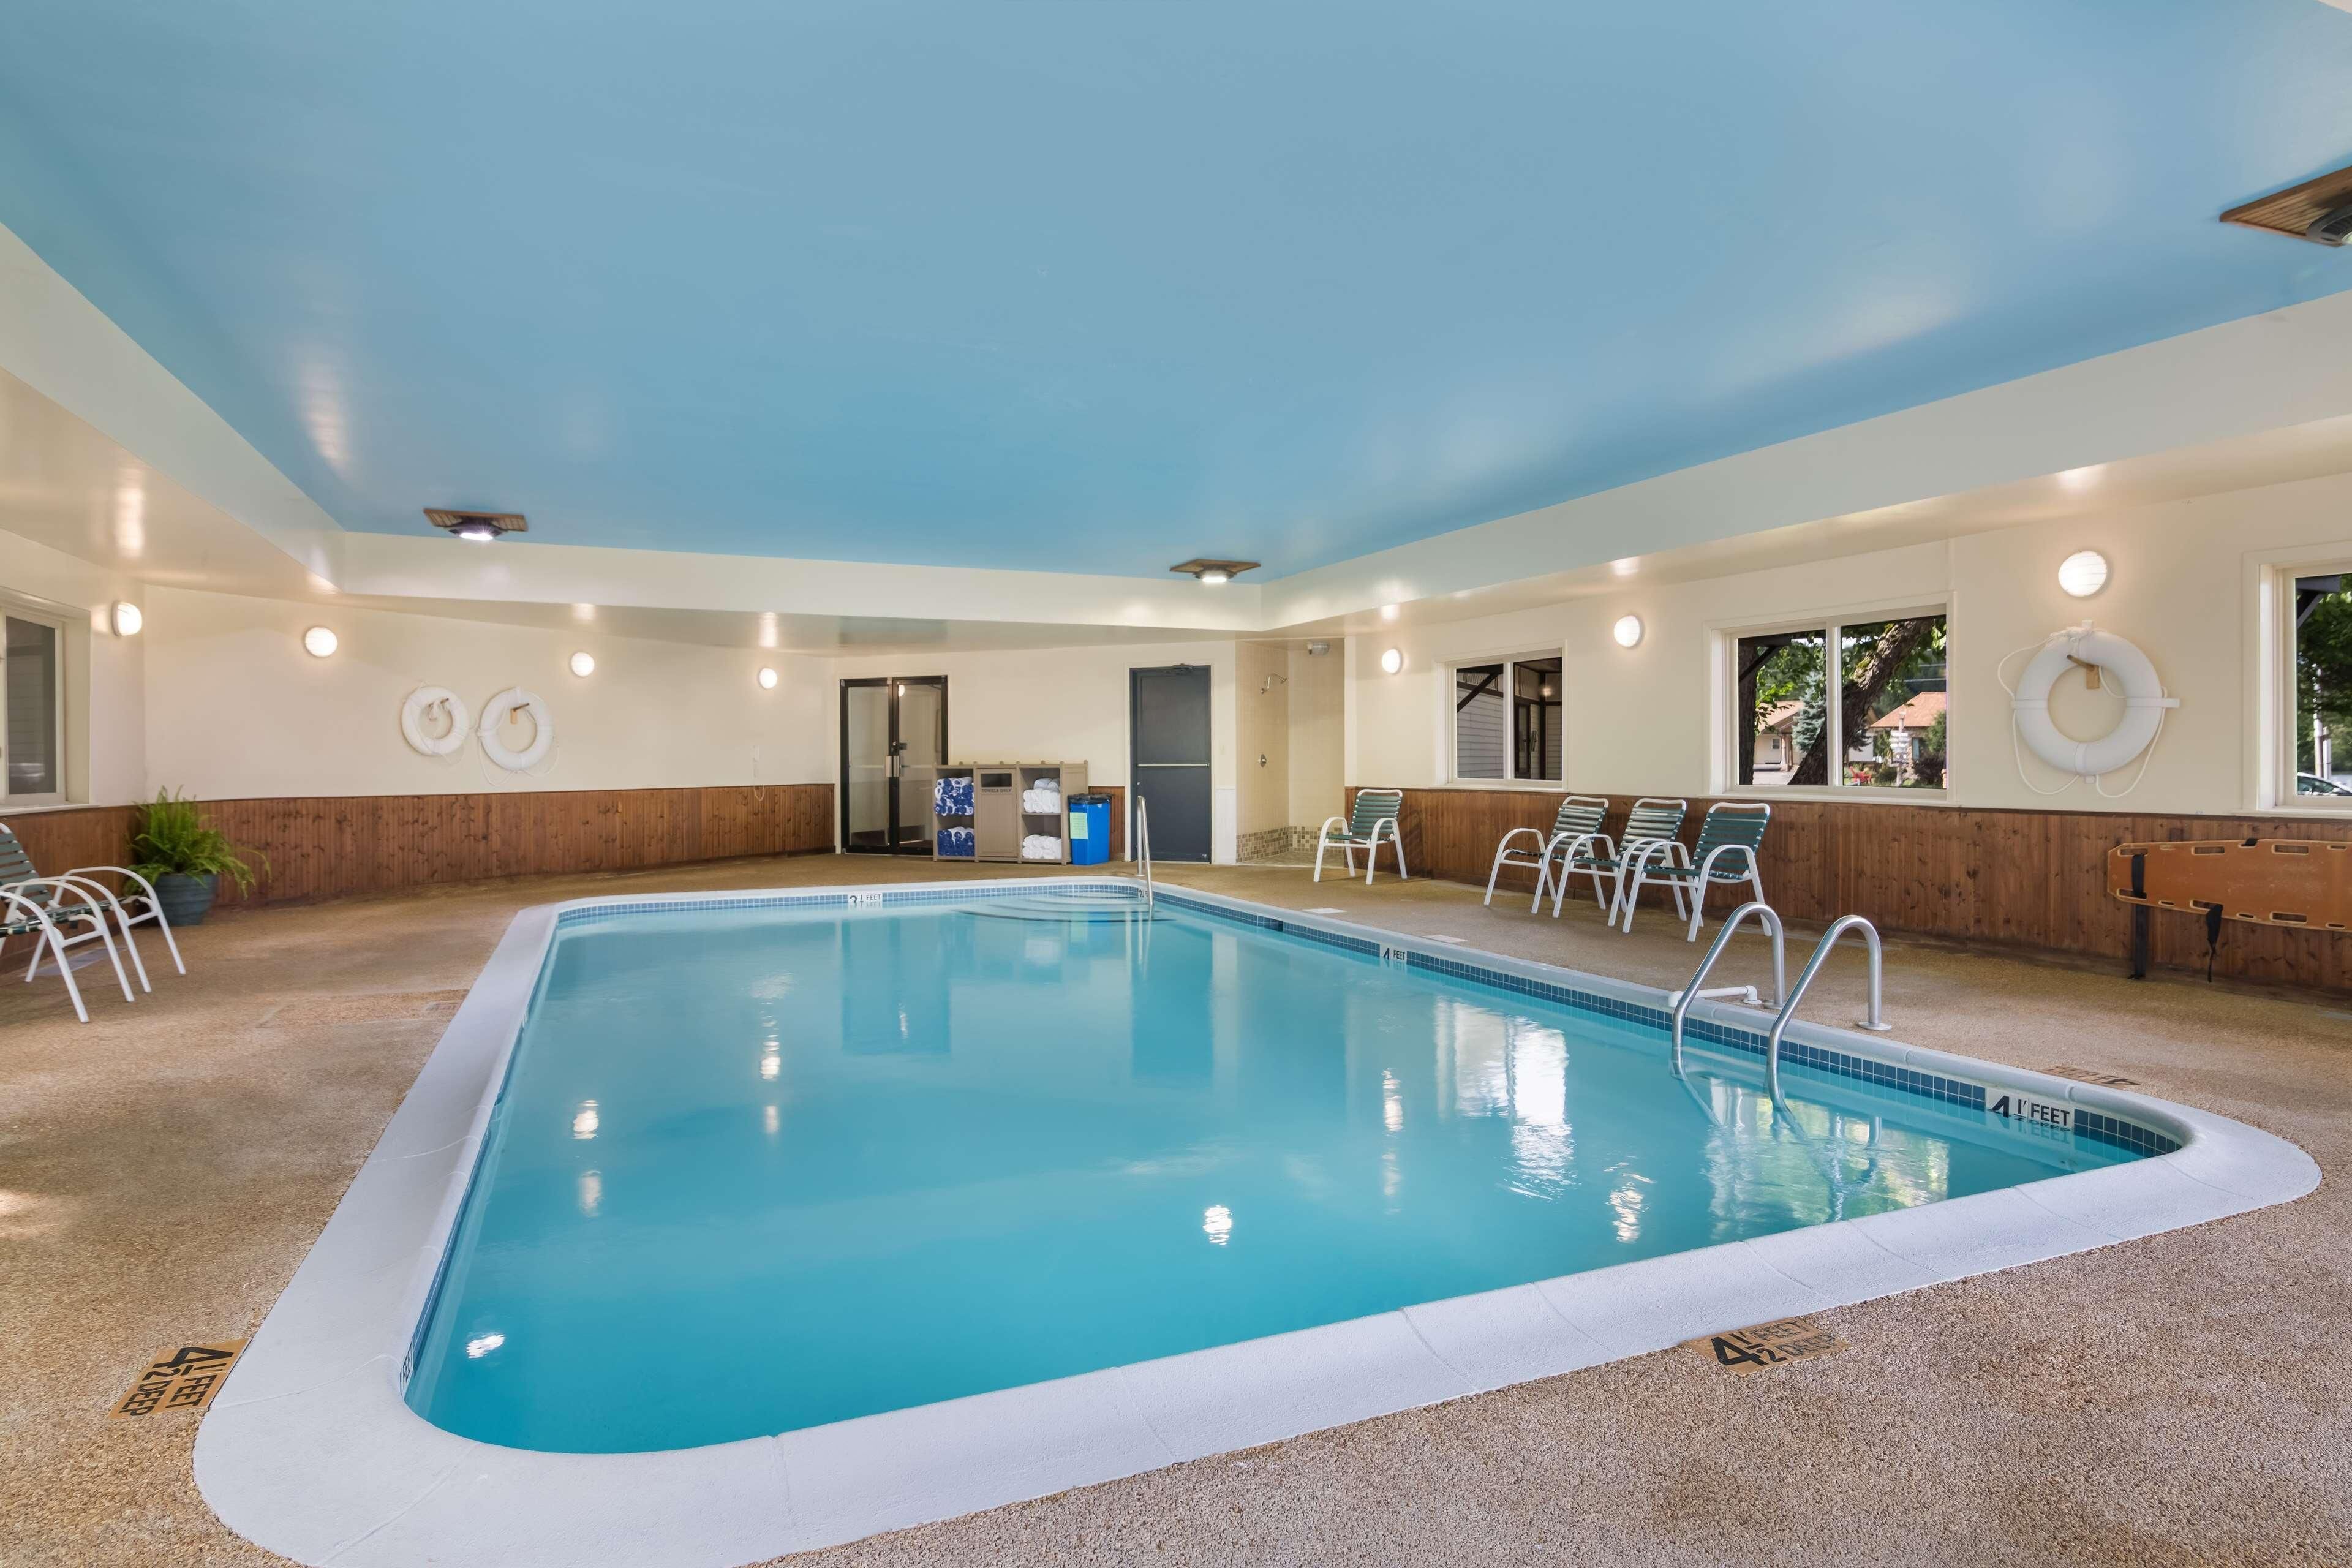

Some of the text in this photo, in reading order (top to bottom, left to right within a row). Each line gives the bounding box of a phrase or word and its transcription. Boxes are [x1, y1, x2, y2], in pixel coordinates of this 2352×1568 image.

[1393, 950, 1405, 960] FEET
[2031, 1102, 2070, 1126] FEET
[119, 1380, 173, 1416] DEEP
[165, 1375, 217, 1408] FEET
